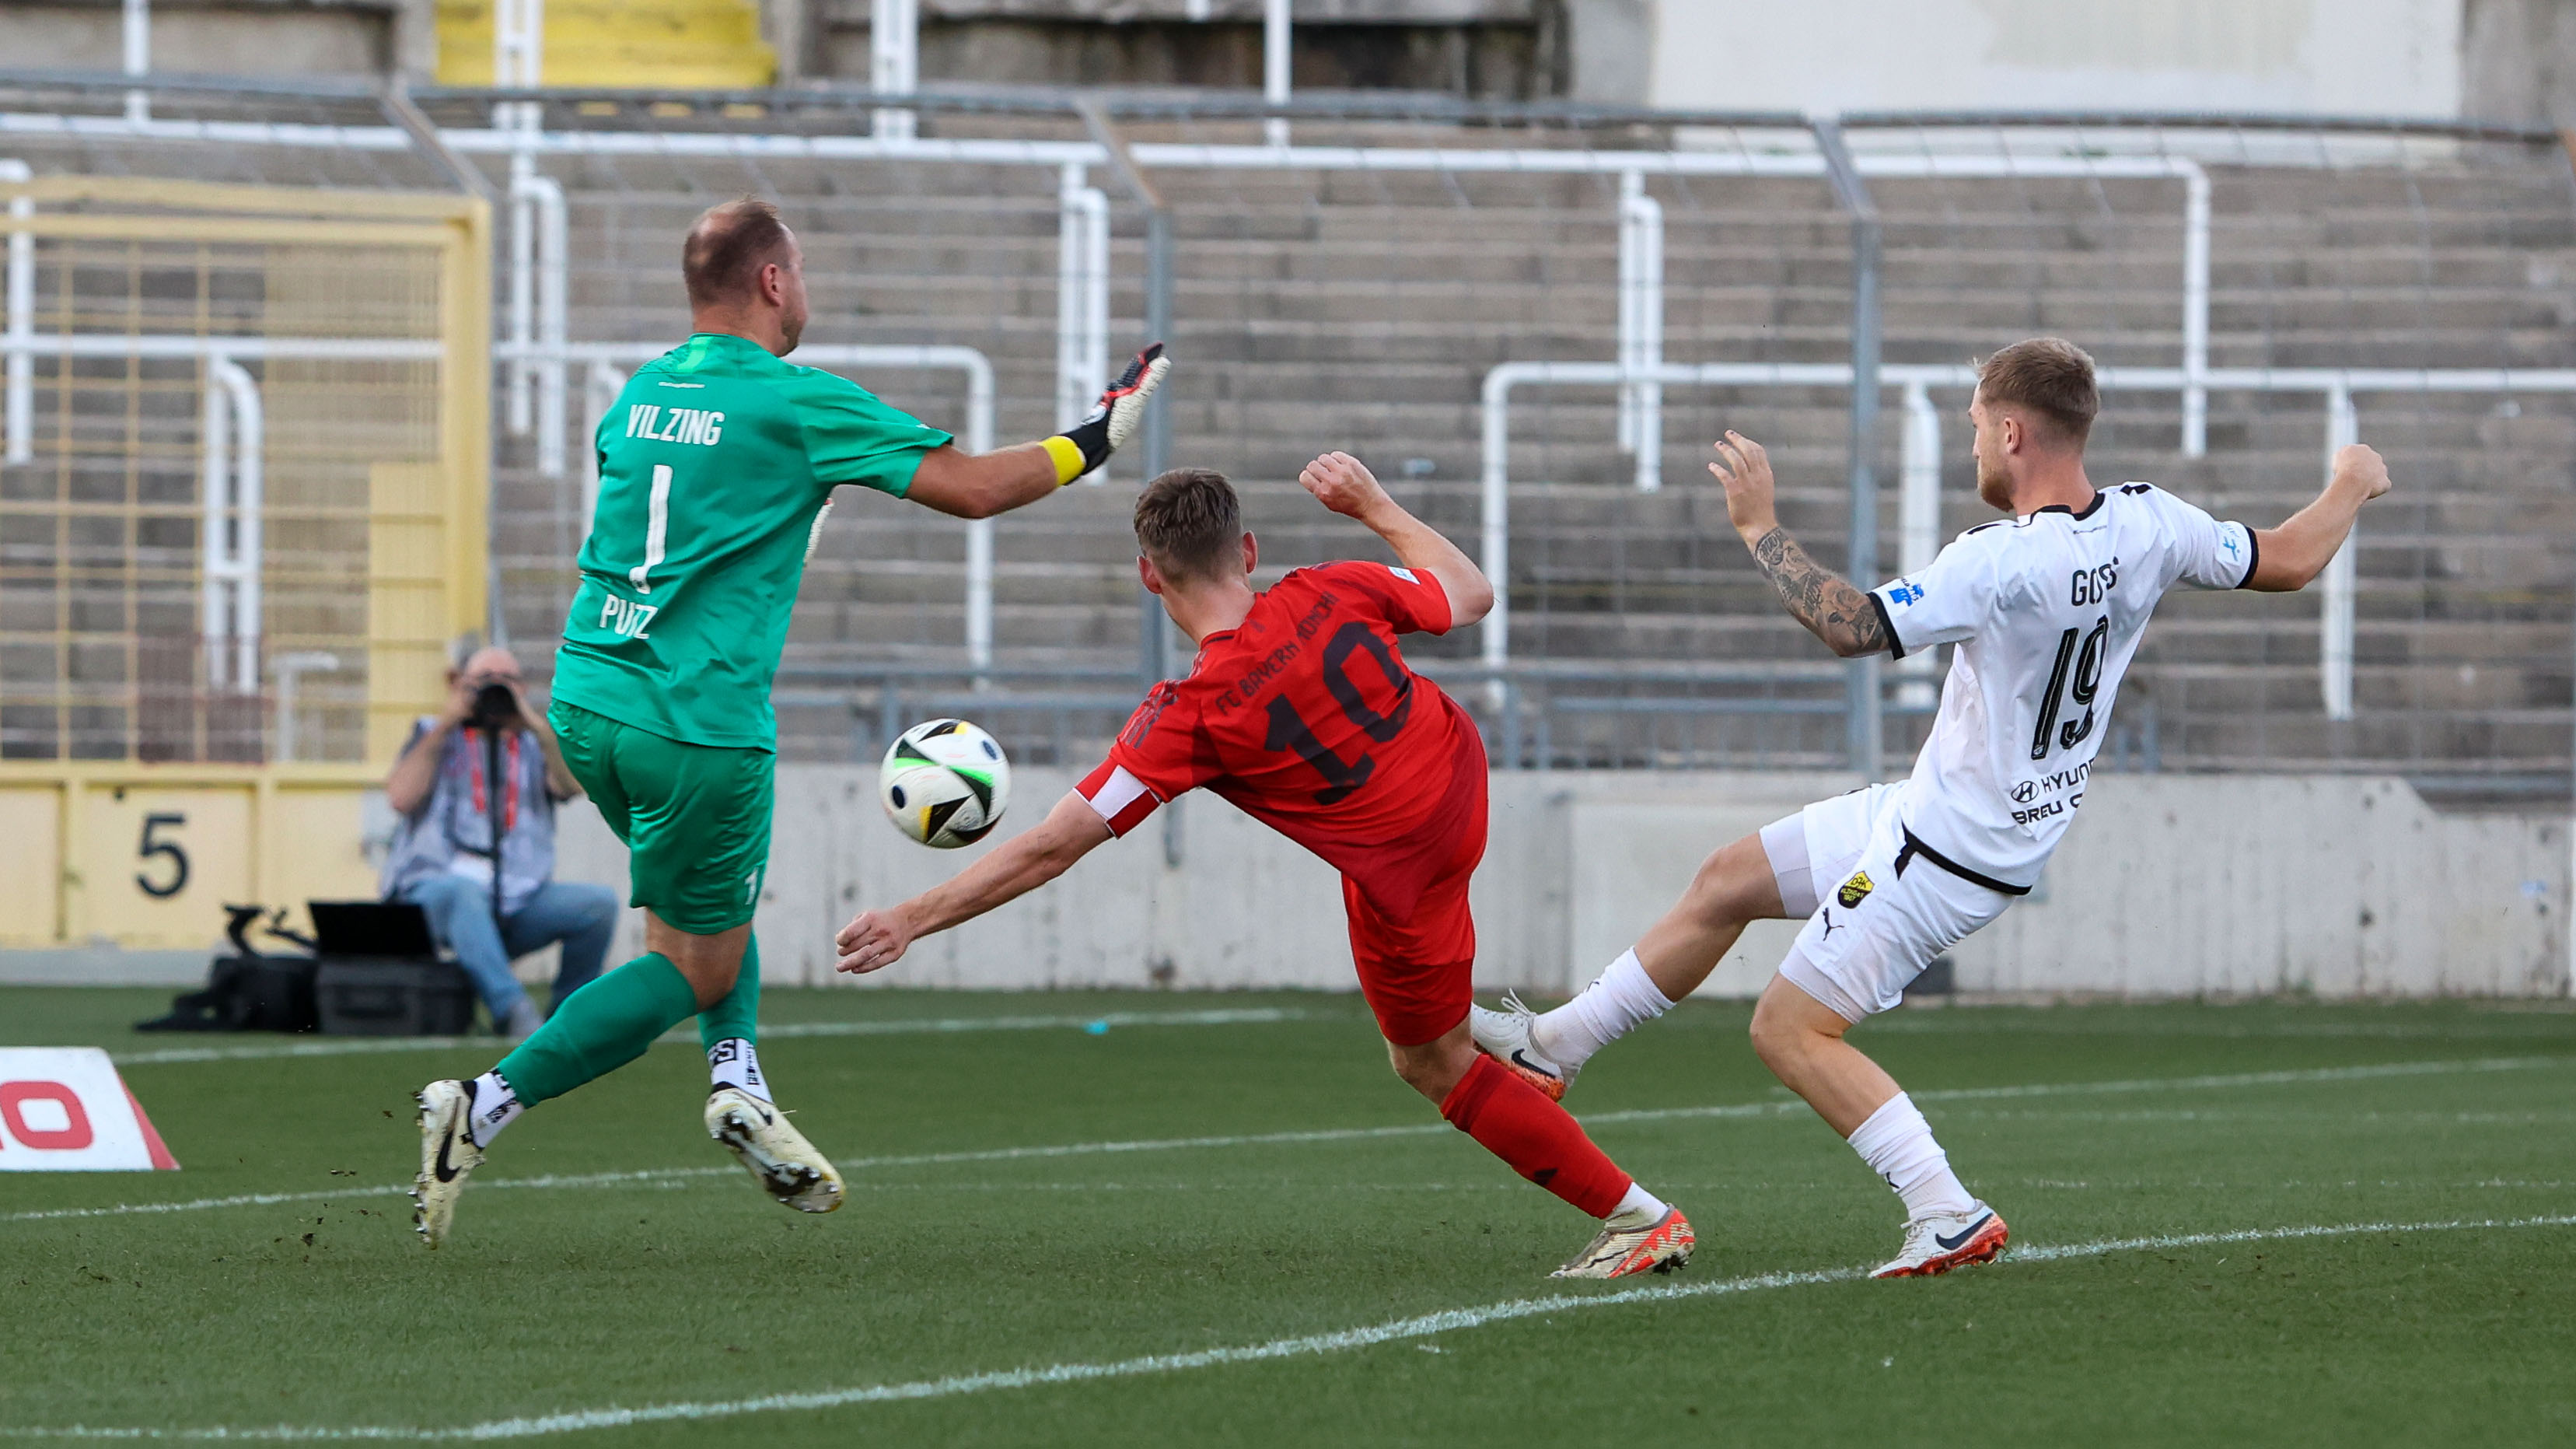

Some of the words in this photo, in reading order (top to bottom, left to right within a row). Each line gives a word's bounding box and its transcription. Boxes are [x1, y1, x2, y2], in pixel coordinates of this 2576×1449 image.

[625, 404, 725, 446] VILZING
[629, 464, 673, 595] 1
[1215, 689, 1243, 716] FC
[1239, 639, 1301, 698] BAYERN
[1263, 621, 1414, 806] 10
[2030, 614, 2109, 761] 19
[135, 813, 190, 898] 5
[744, 866, 759, 905] 1
[0, 1080, 94, 1150] O
